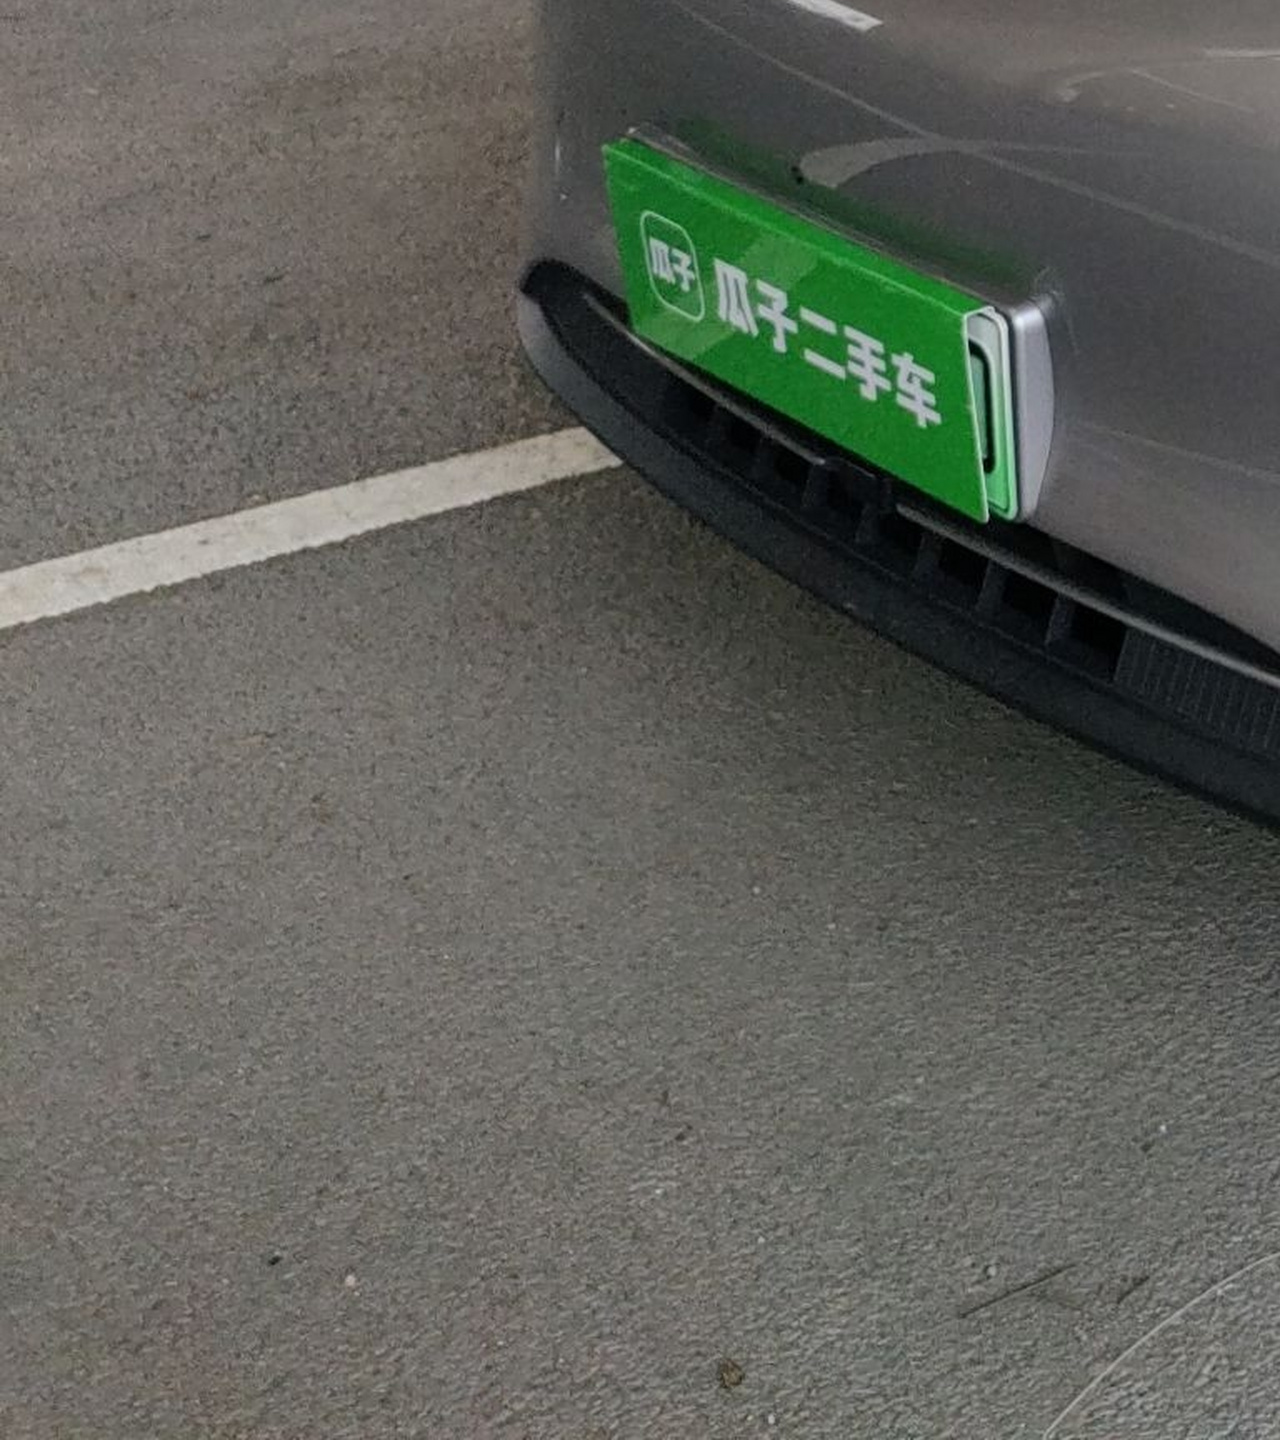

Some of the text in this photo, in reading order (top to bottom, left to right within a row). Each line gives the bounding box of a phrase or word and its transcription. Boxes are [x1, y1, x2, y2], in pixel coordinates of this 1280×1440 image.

[648, 237, 696, 292] 瓜子
[714, 258, 942, 429] 瓜子二手车
